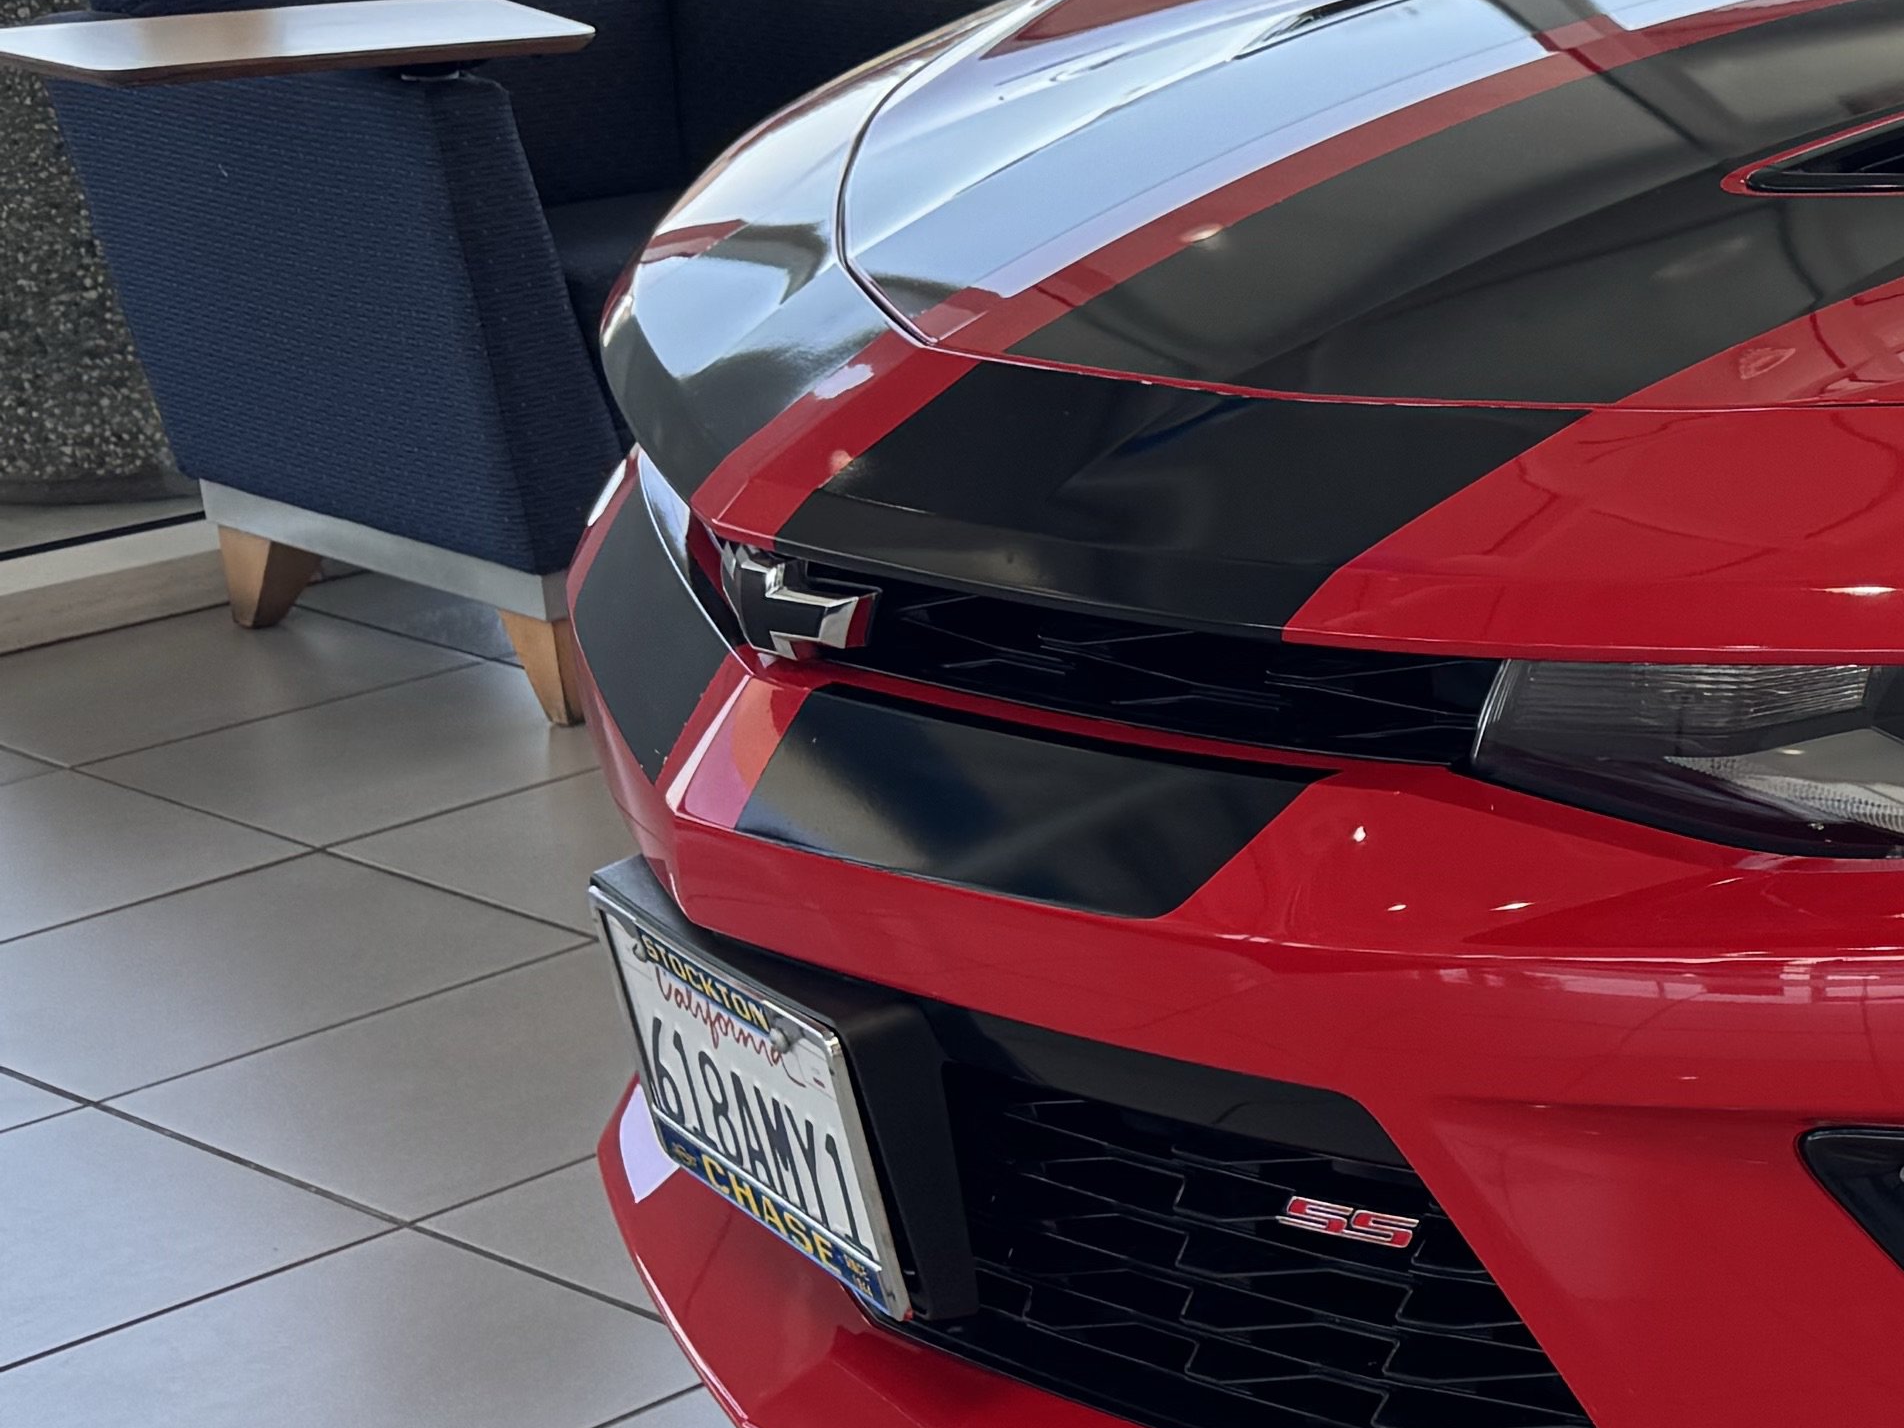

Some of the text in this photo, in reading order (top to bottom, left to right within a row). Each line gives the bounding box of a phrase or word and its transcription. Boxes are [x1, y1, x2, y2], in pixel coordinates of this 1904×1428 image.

[642, 934, 771, 1032] STOCKTON
[655, 966, 800, 1085] California
[652, 1016, 873, 1259] 618AMY1
[702, 1152, 842, 1275] CHASE
[1275, 1195, 1420, 1248] SS
